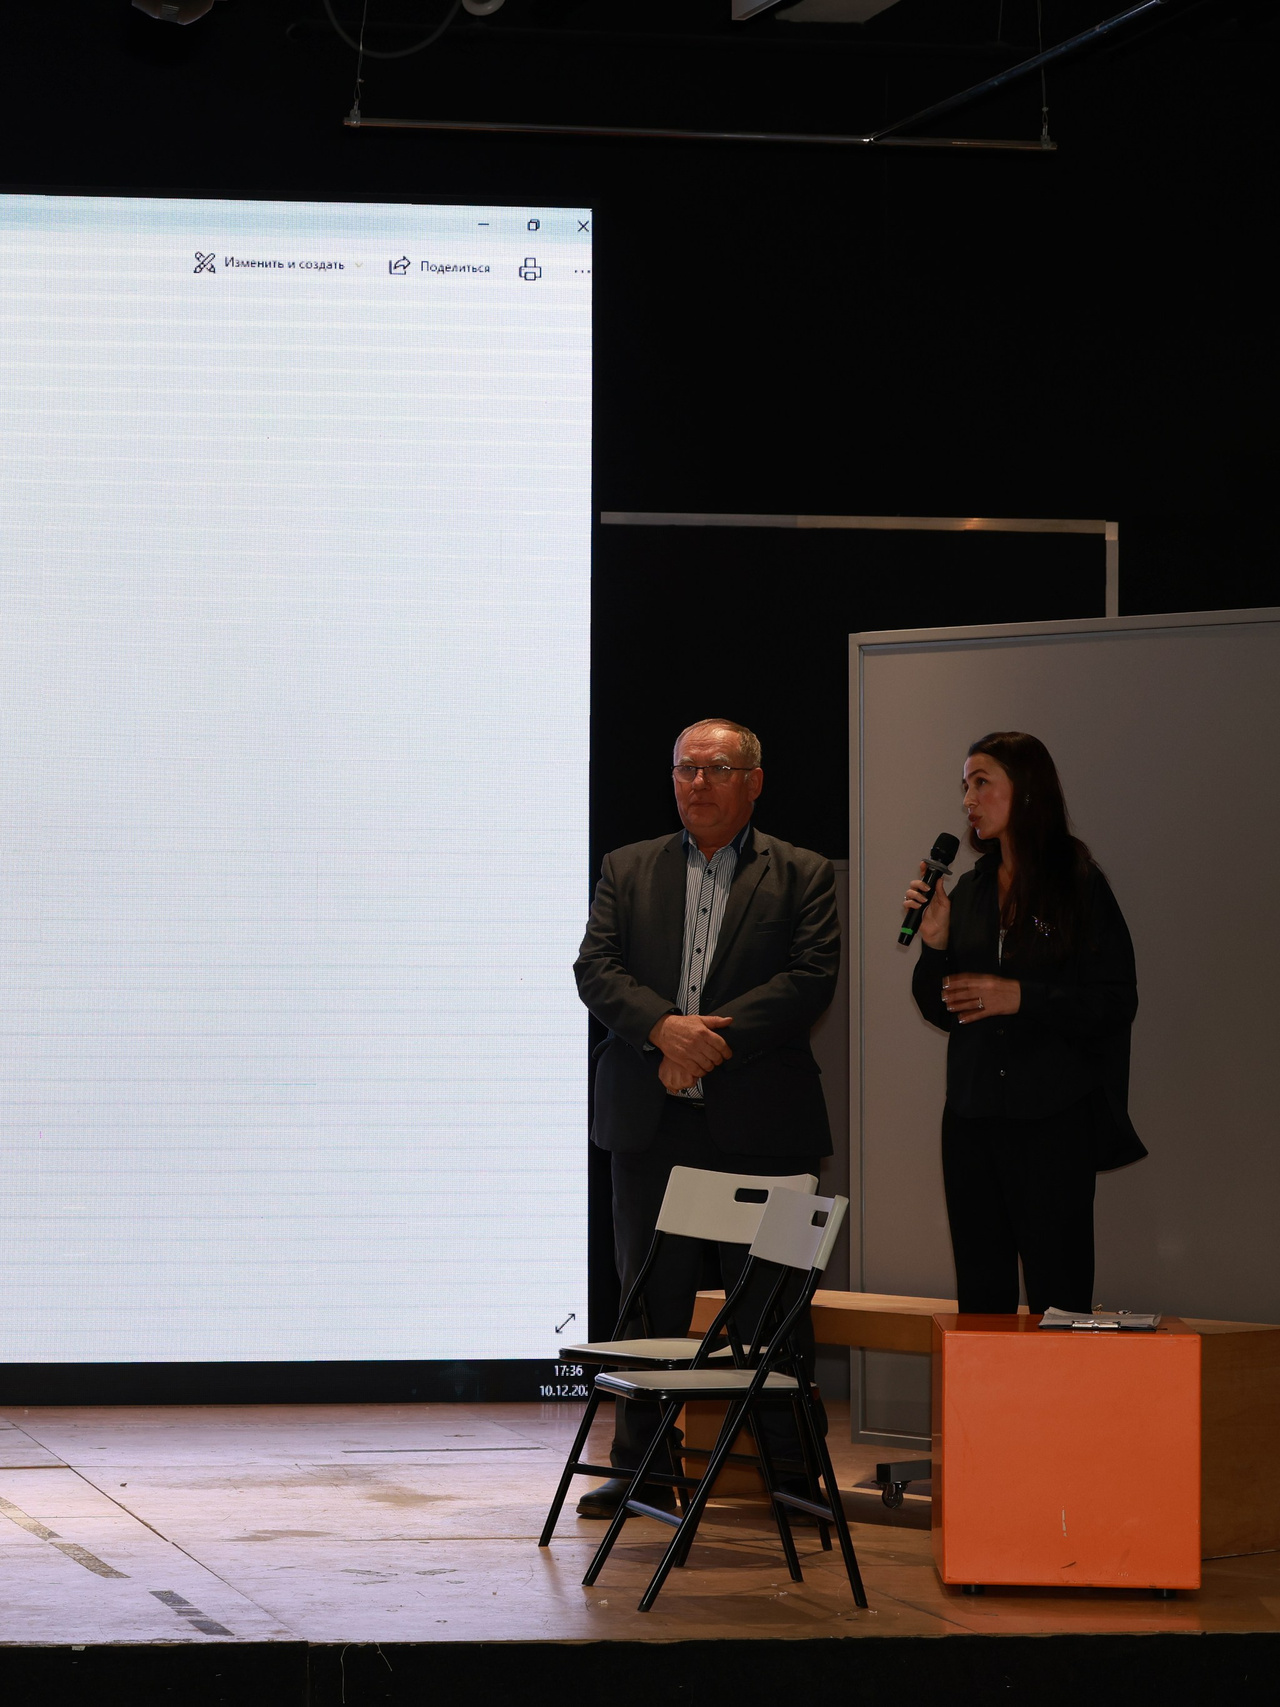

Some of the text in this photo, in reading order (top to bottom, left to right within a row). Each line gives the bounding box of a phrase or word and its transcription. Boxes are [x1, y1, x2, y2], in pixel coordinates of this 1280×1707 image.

[223, 255, 346, 272] Изменить и создать
[420, 260, 490, 274] Поделиться
[554, 1364, 584, 1377] 17:36
